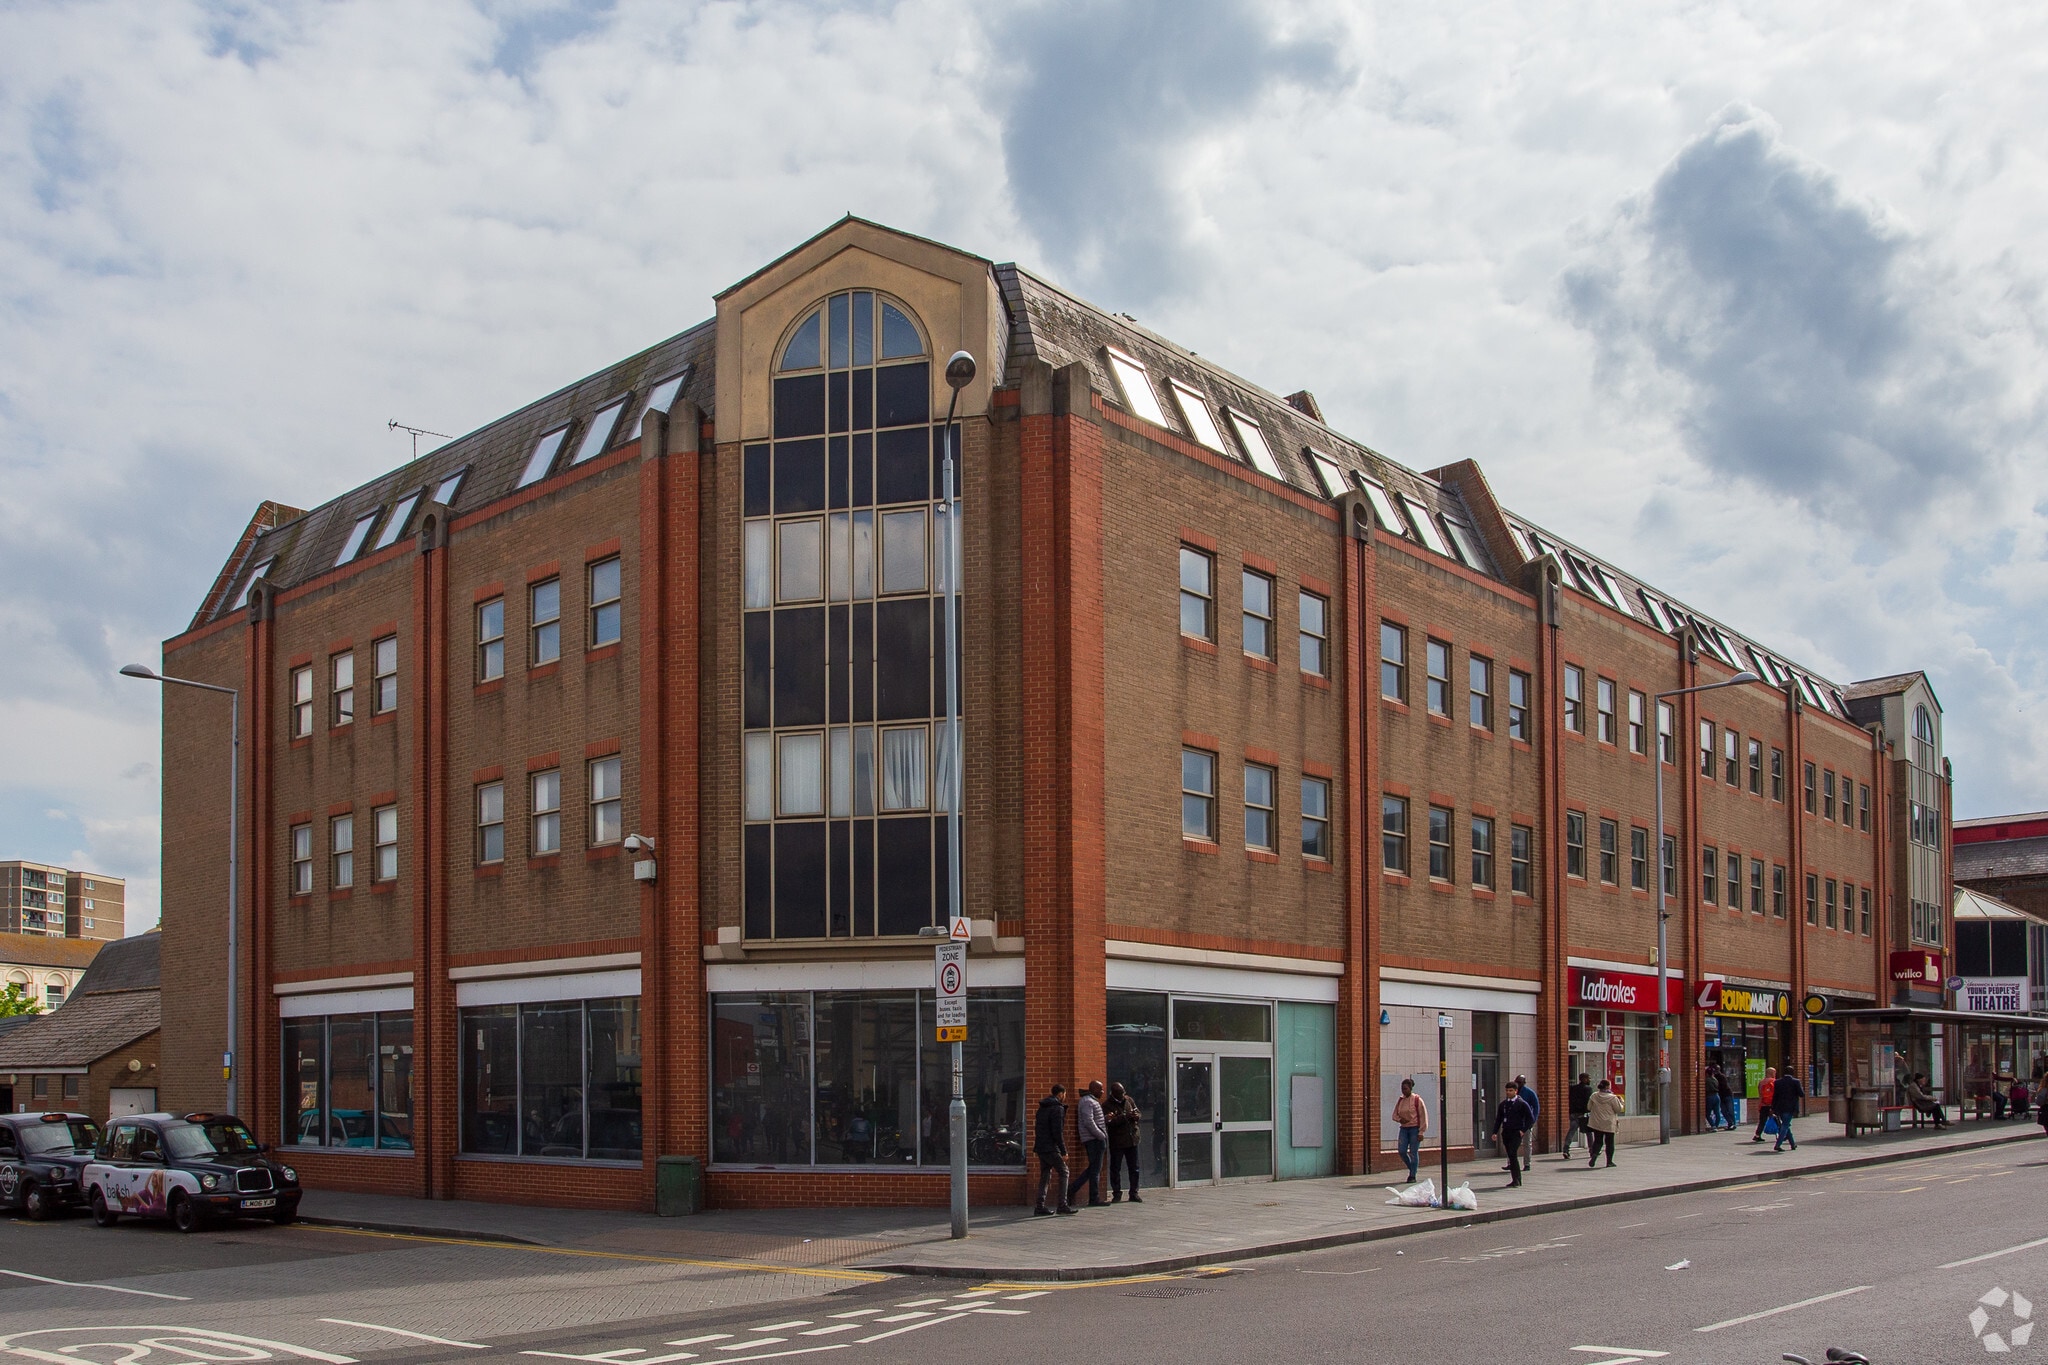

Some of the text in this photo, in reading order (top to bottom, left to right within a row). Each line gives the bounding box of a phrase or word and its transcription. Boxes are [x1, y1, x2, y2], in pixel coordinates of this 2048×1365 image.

[942, 952, 959, 961] ZONE
[1894, 968, 1922, 979] wilko
[1581, 975, 1636, 1004] Ladbrokes
[1988, 986, 2016, 995] PEOPLE'S
[1721, 989, 1775, 1014] POUNDMART
[1967, 995, 2016, 1010] THEATRE
